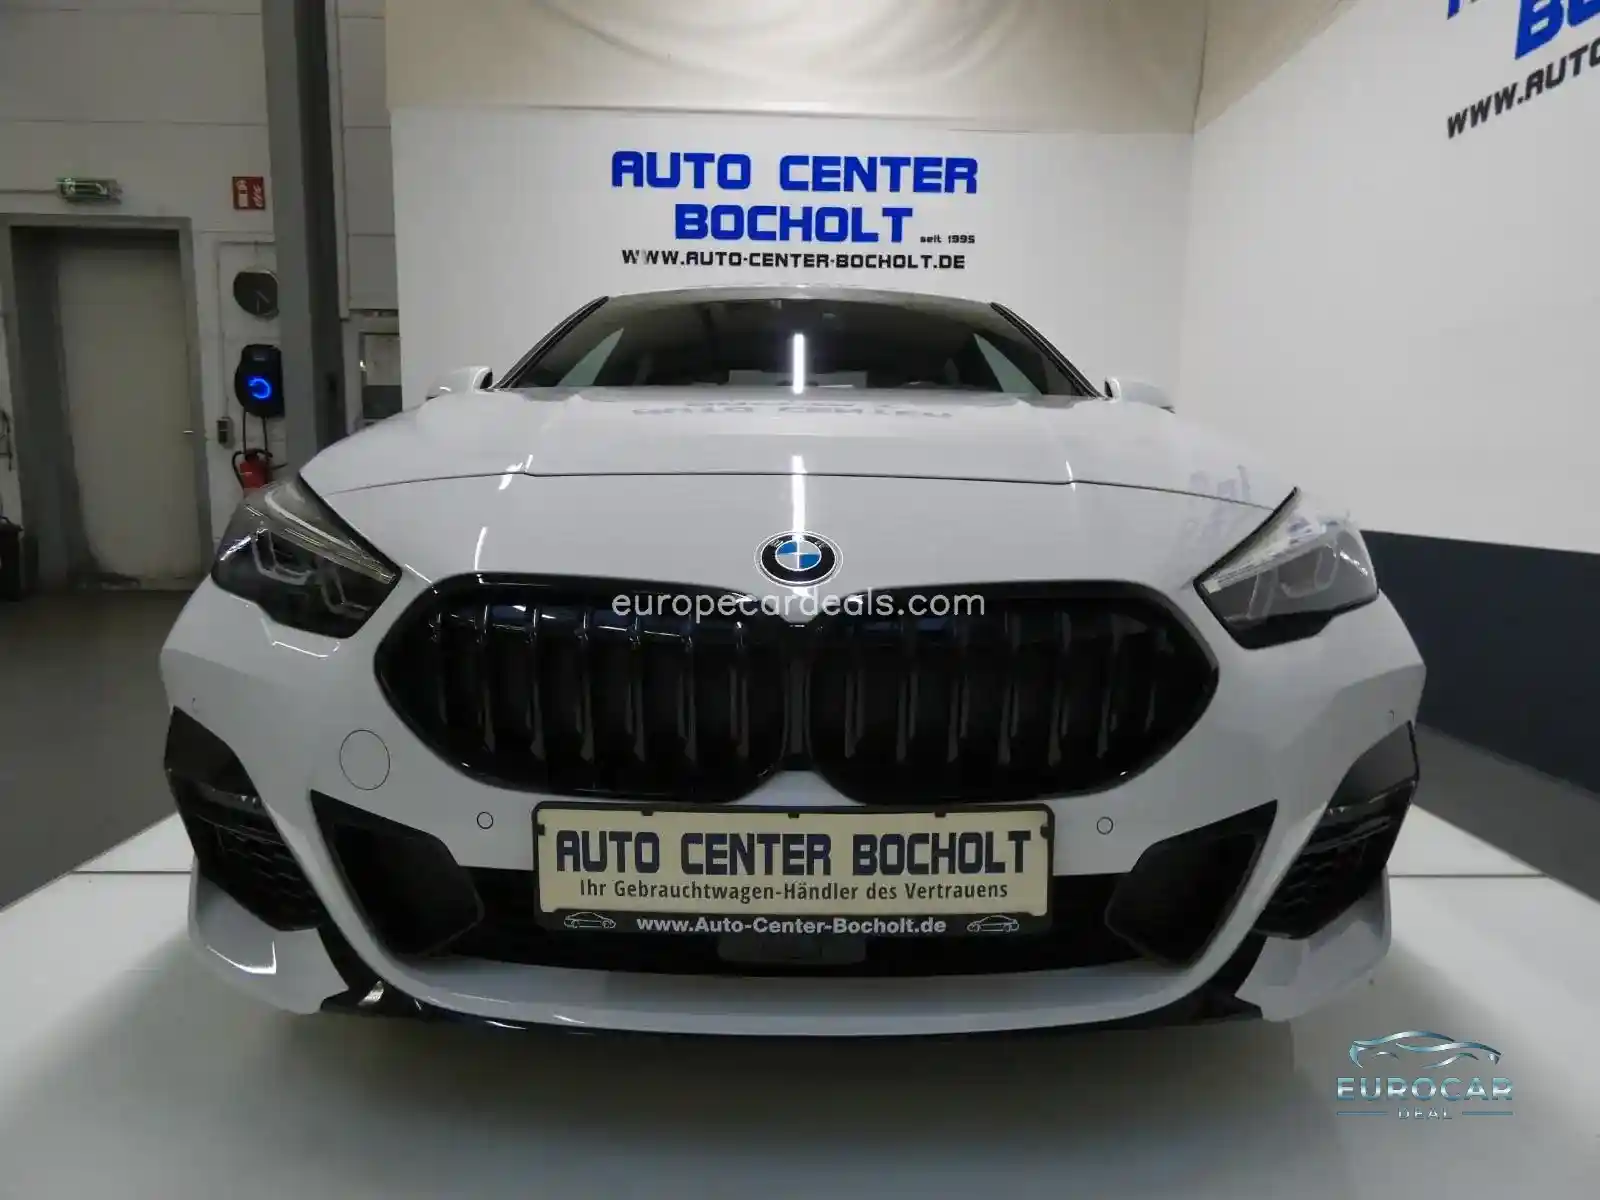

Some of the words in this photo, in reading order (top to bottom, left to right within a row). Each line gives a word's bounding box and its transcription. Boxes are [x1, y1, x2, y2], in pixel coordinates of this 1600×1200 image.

[612, 151, 750, 190] AUTO
[779, 155, 978, 194] CENTER
[675, 204, 913, 243] BOCHOLT
[920, 234, 942, 244] seit
[948, 234, 976, 244] 1995
[622, 249, 965, 270] WWW.AUTO-CENTER-BOCHOLT.DE
[556, 830, 660, 874] AUTO
[681, 832, 832, 876] CENTER
[852, 830, 1032, 876] BOCHOLT
[580, 879, 607, 897] Ihr
[614, 879, 859, 905] Gebrauchtwagen-Händler
[866, 882, 898, 900] des
[904, 882, 1009, 899] Vertrauens
[636, 917, 947, 935] www.Auto-Center-Bocholt.de
